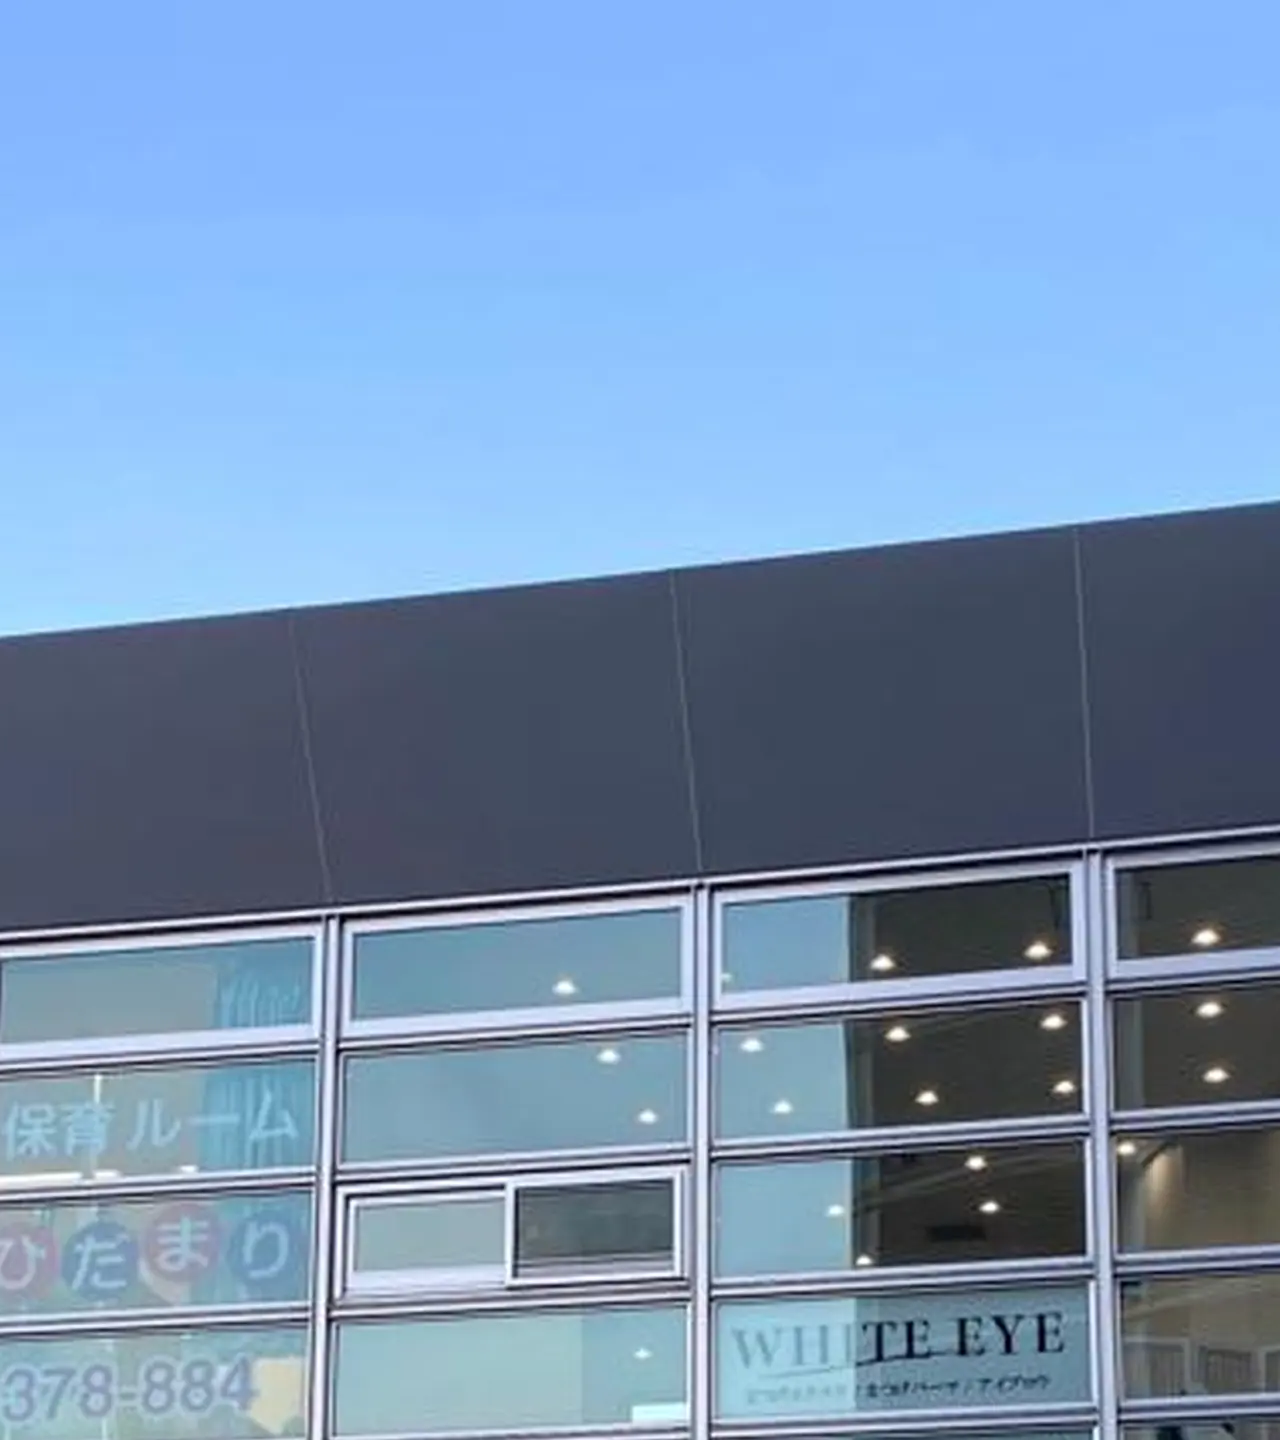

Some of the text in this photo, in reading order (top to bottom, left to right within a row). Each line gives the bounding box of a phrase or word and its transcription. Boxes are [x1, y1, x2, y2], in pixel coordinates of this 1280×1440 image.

[1, 1090, 300, 1157] 保育ルーム
[731, 1310, 1066, 1369] WHITE EYE
